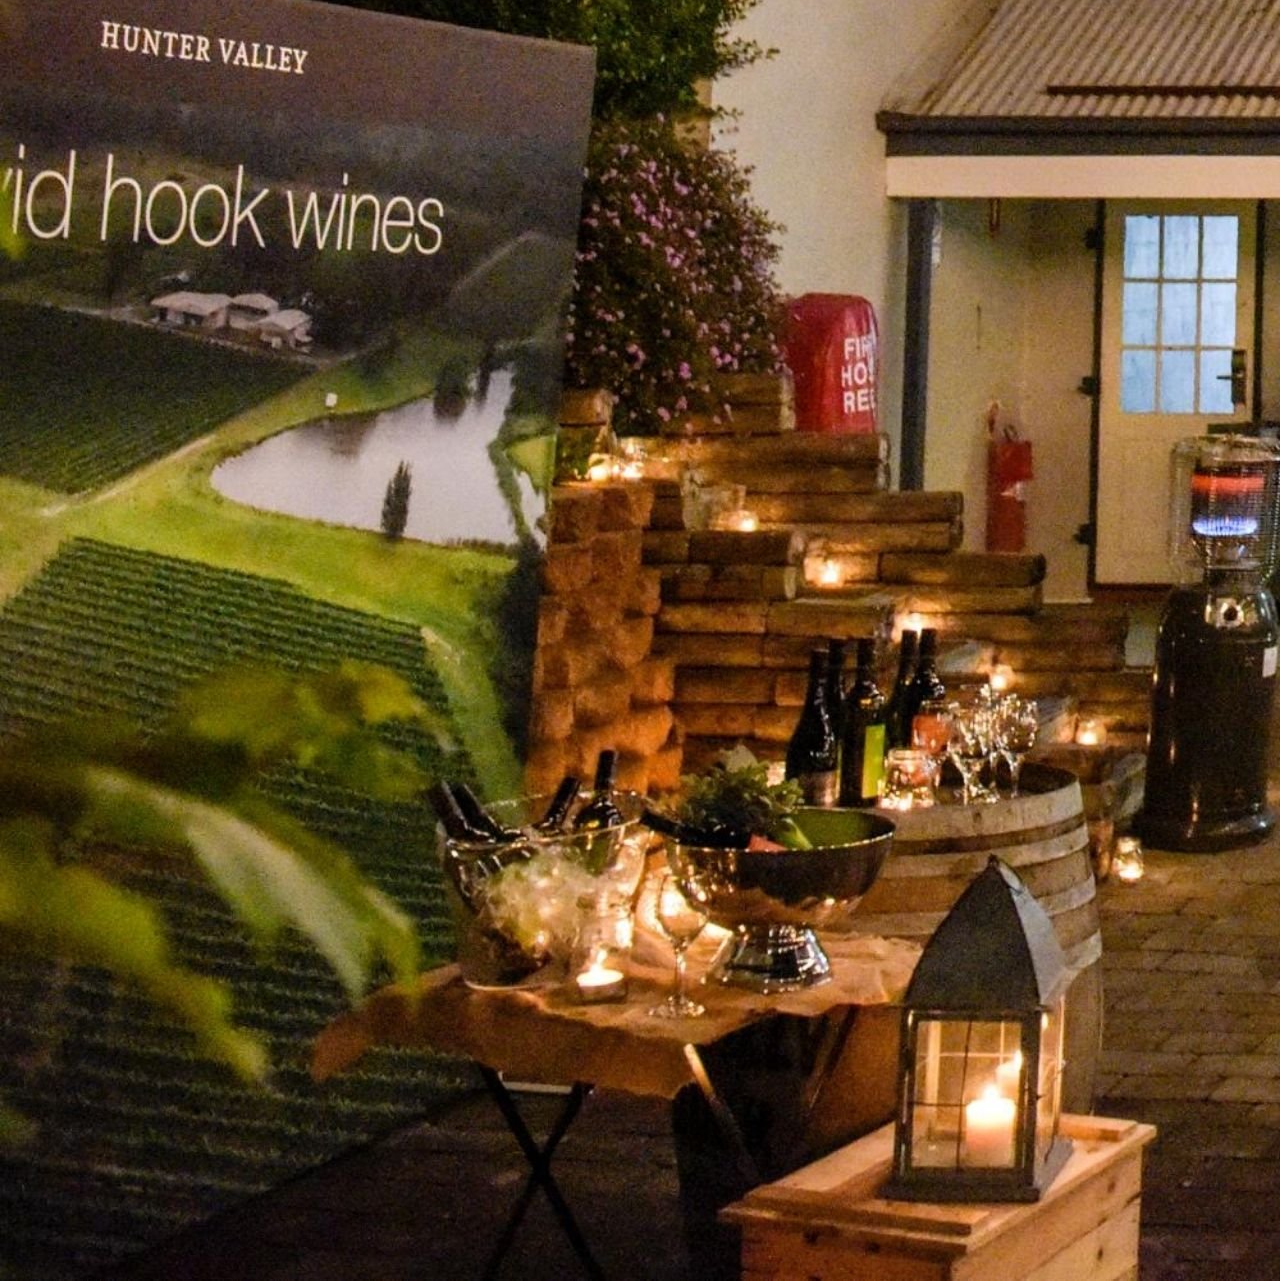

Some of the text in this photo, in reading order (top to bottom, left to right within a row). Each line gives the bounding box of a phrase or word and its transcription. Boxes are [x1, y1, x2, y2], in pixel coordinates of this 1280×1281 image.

[101, 20, 309, 75] HUNTER VALLEY
[2, 143, 445, 255] id hook wines
